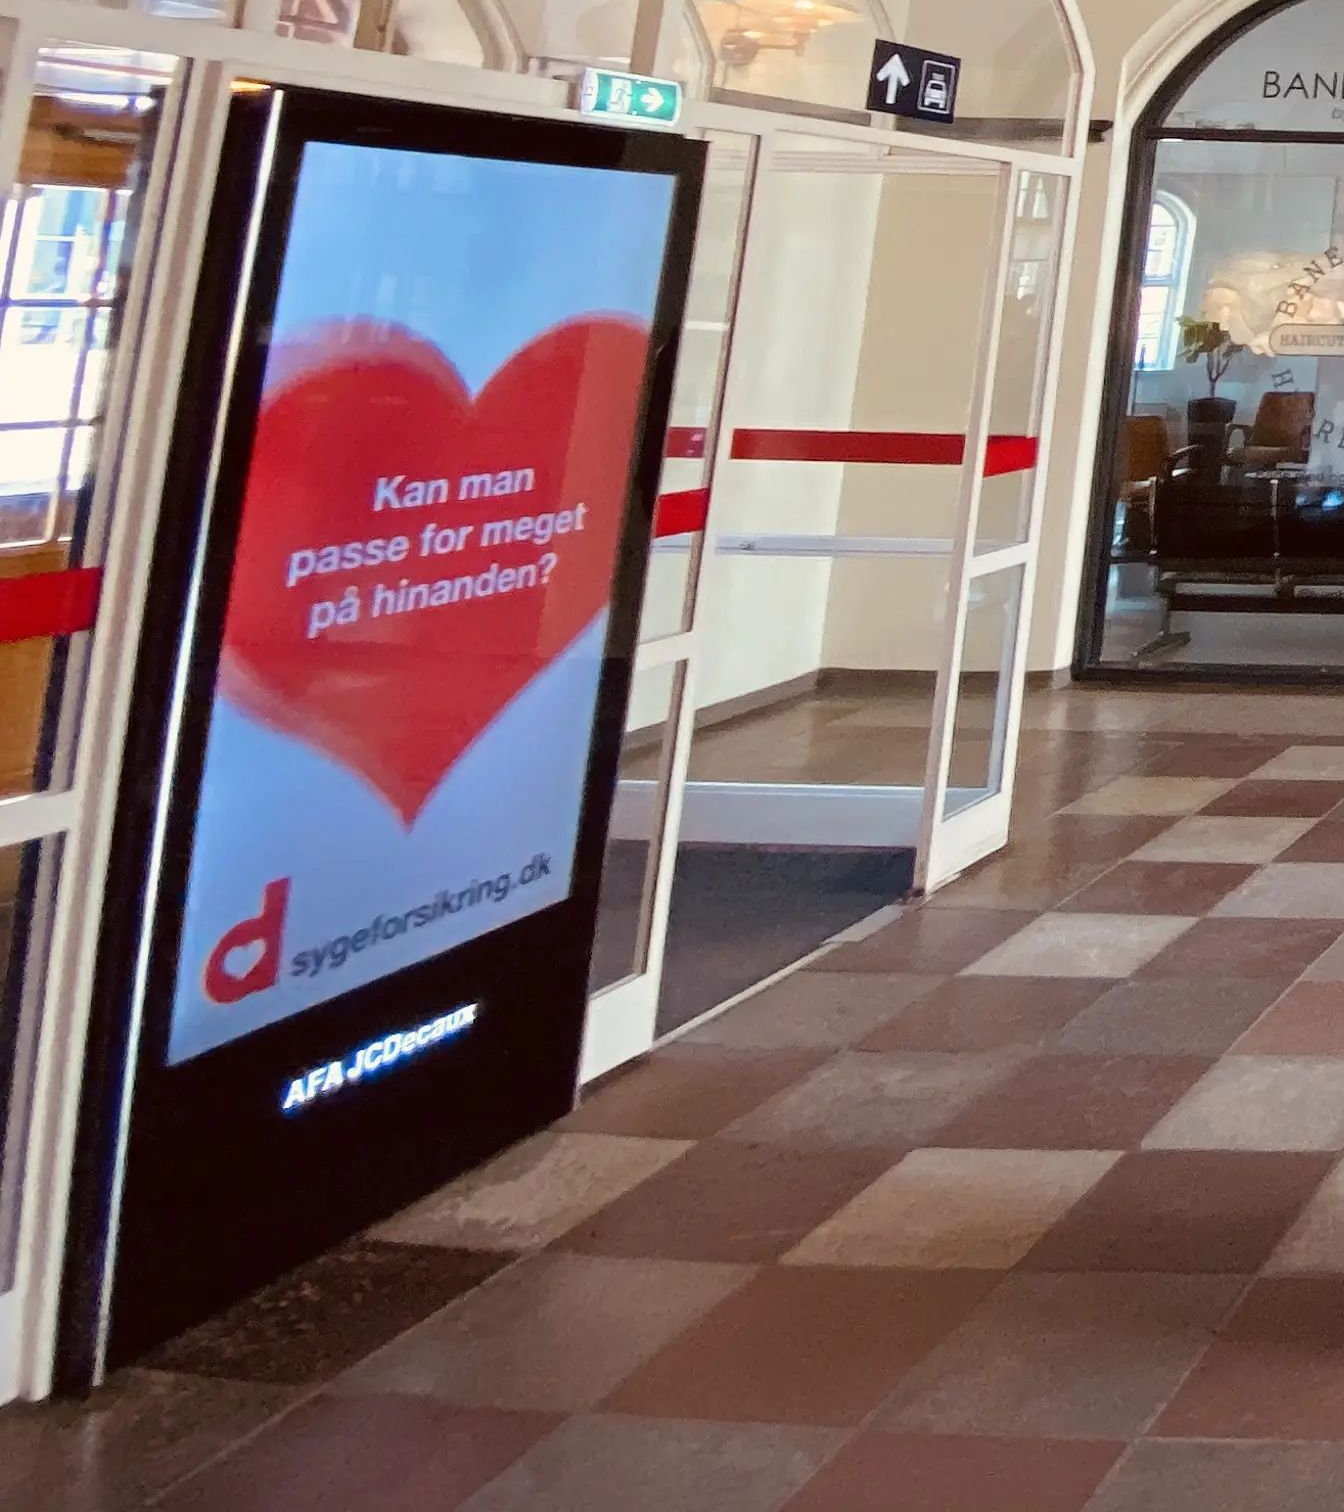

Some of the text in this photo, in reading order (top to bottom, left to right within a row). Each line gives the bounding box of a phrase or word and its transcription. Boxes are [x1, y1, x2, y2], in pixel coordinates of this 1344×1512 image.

[372, 467, 535, 511] Kan man
[286, 502, 588, 588] passe for meget
[306, 552, 558, 639] på hinanden?
[288, 852, 552, 978] sygeforsikring.dk
[280, 1002, 480, 1112] AFA JCDecaux
